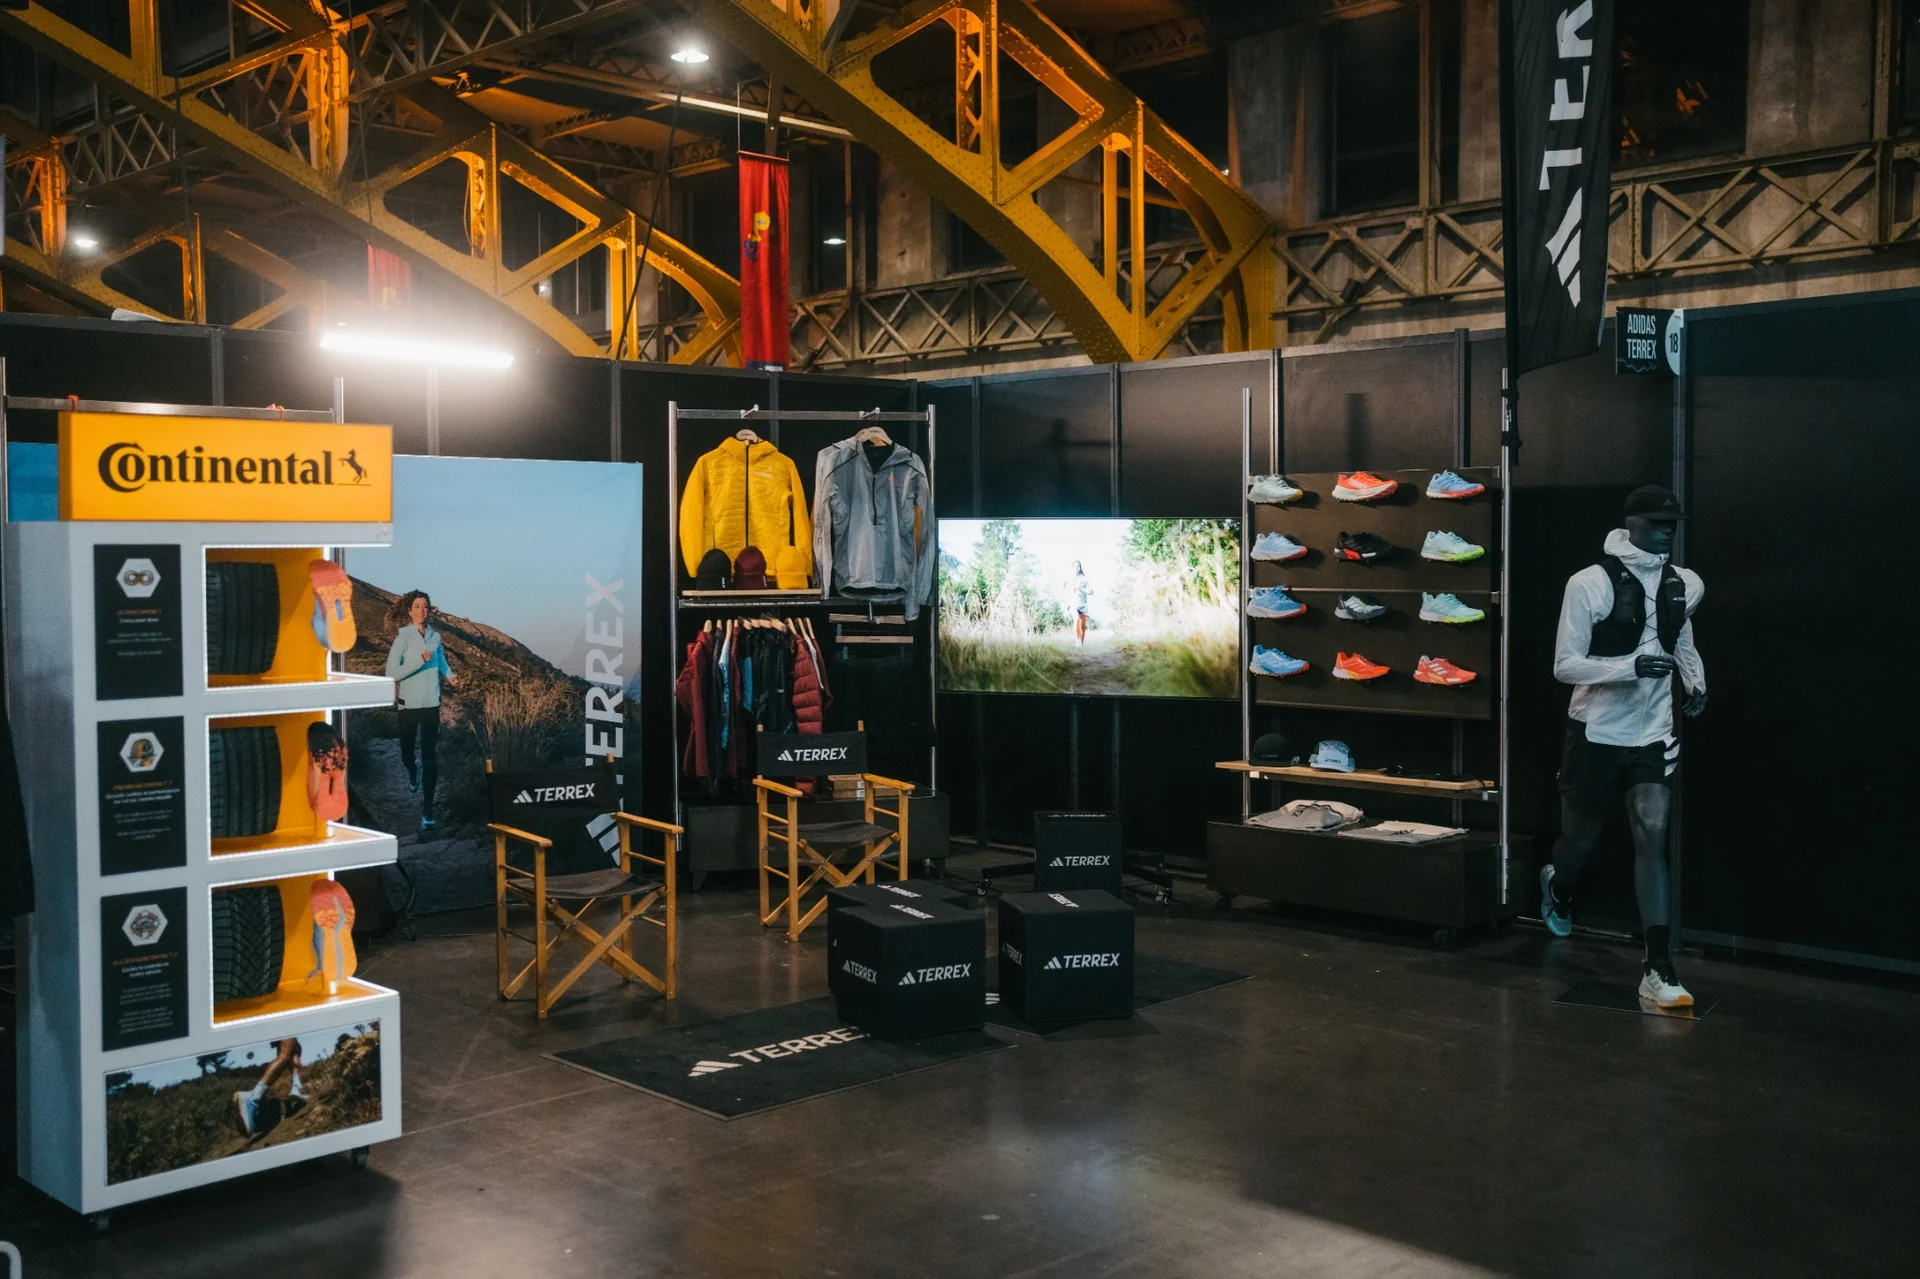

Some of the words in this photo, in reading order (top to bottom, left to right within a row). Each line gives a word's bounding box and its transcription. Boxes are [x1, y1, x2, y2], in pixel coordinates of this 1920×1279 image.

[1627, 314, 1656, 335] ADIDAS
[1626, 338, 1657, 360] TERREX
[1669, 333, 1679, 353] 18
[98, 441, 334, 493] Continental
[585, 570, 624, 784] ERREX
[795, 747, 848, 762] TERREX
[534, 783, 595, 803] TERREX
[1065, 855, 1110, 866] TERREX
[1063, 953, 1121, 970] TERREX
[849, 960, 878, 985] TERREX
[917, 963, 972, 983] TERREX
[729, 1026, 871, 1063] TERRE
